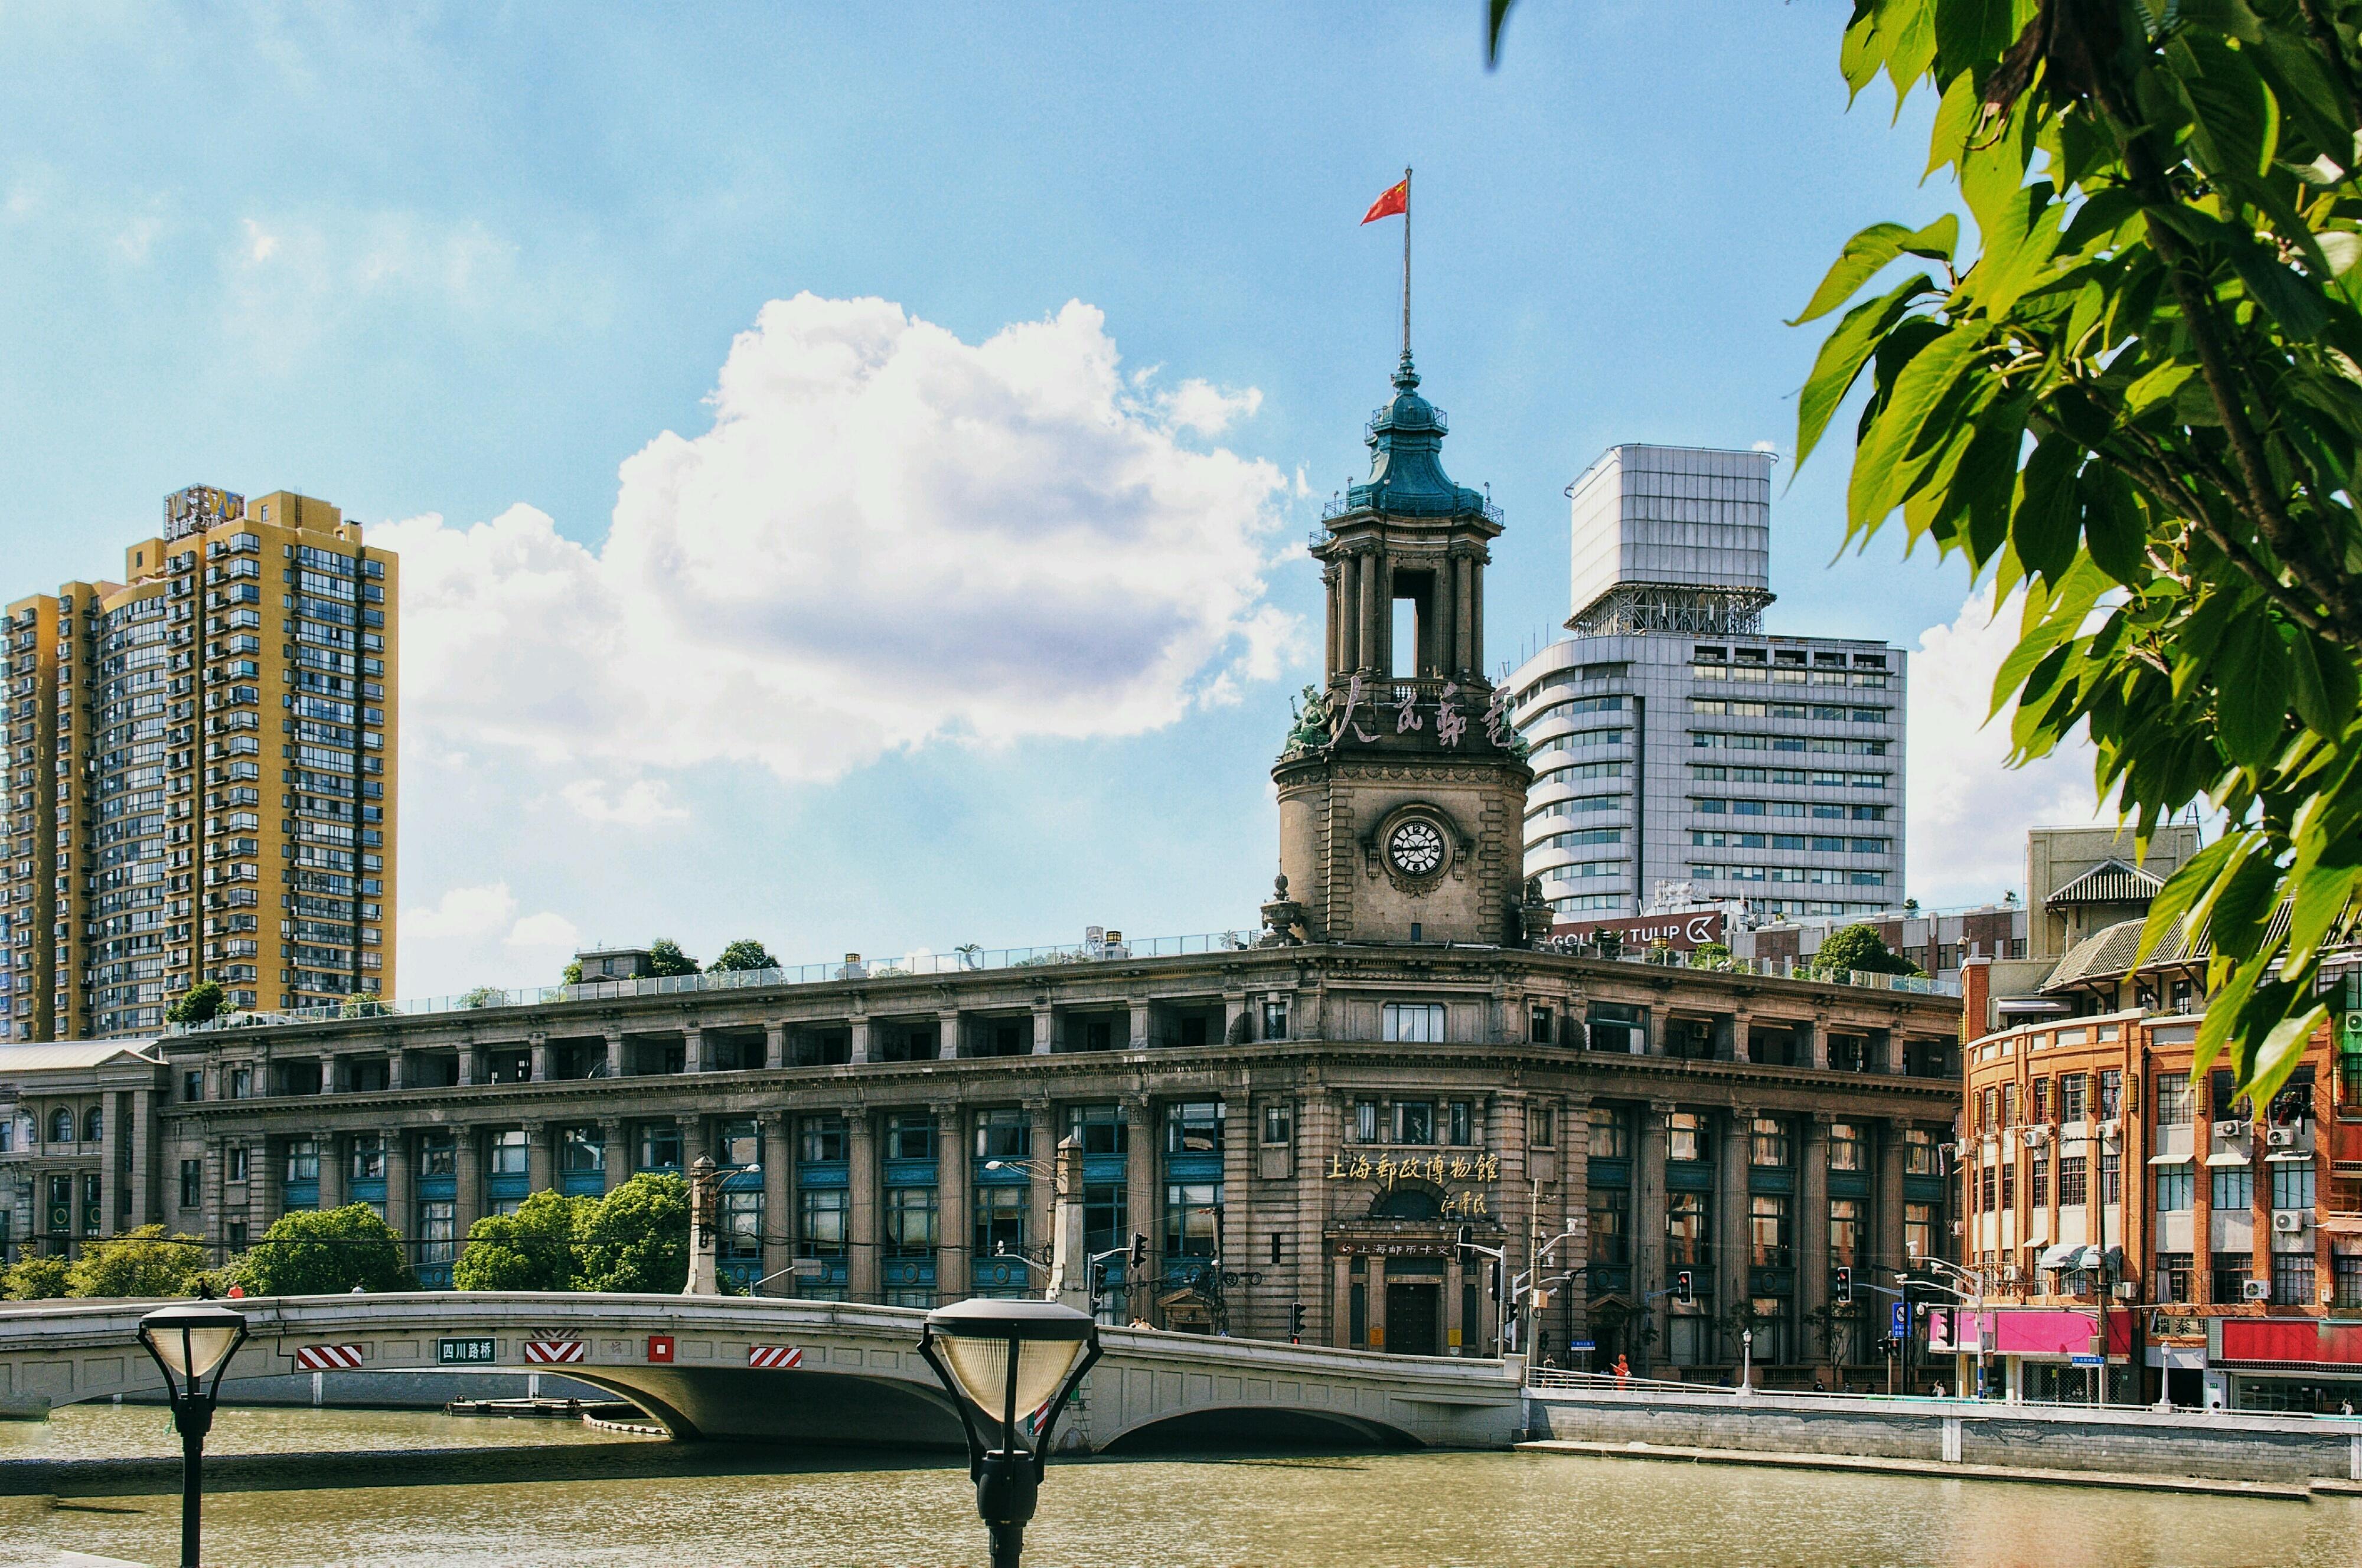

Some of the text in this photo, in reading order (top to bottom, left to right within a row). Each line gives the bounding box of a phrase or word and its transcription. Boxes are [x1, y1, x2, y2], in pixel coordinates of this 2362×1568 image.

[1629, 925, 1680, 943] TULIP
[443, 1341, 491, 1359] 四川路桥
